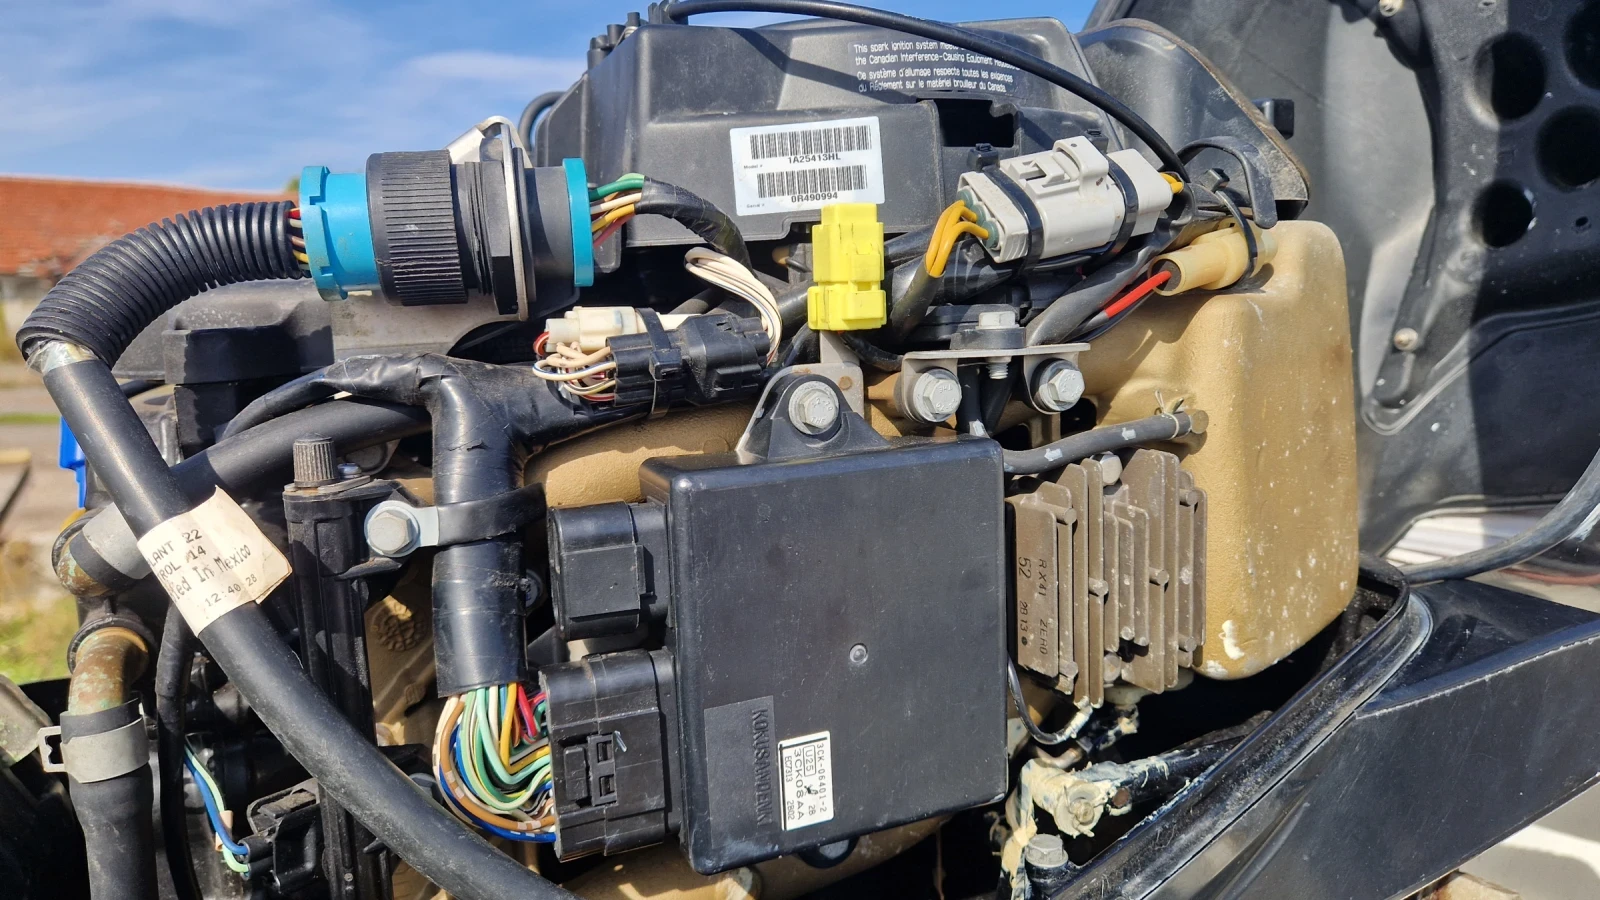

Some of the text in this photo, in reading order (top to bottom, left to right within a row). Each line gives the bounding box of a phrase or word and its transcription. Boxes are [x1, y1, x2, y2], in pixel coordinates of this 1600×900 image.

[854, 44, 868, 53] This
[870, 42, 889, 52] spark
[891, 41, 913, 51] ignition
[915, 41, 938, 50] system
[855, 56, 867, 65] the
[869, 54, 898, 64] Canadian
[900, 52, 965, 62] Interference-Causing
[966, 53, 993, 65] Equipment
[857, 67, 1013, 83] Ce système d'allumage respecte toutes les exigences
[858, 83, 867, 92] du
[905, 80, 916, 89] sur
[918, 79, 924, 88] le
[926, 78, 952, 88] matériel
[953, 79, 978, 89] brouilleur
[979, 81, 987, 90] du
[788, 153, 842, 164] 1A25413HL
[790, 191, 839, 203] 0R490994
[182, 529, 203, 544] 22
[191, 565, 216, 583] In
[213, 544, 251, 573] Mexico
[1018, 556, 1032, 580] 52
[1040, 618, 1049, 655] ZERO
[784, 755, 794, 783] EC7313
[805, 748, 815, 772] U25
[794, 747, 805, 820] 3CK08AA
[816, 742, 828, 813] 3CK-06401-2
